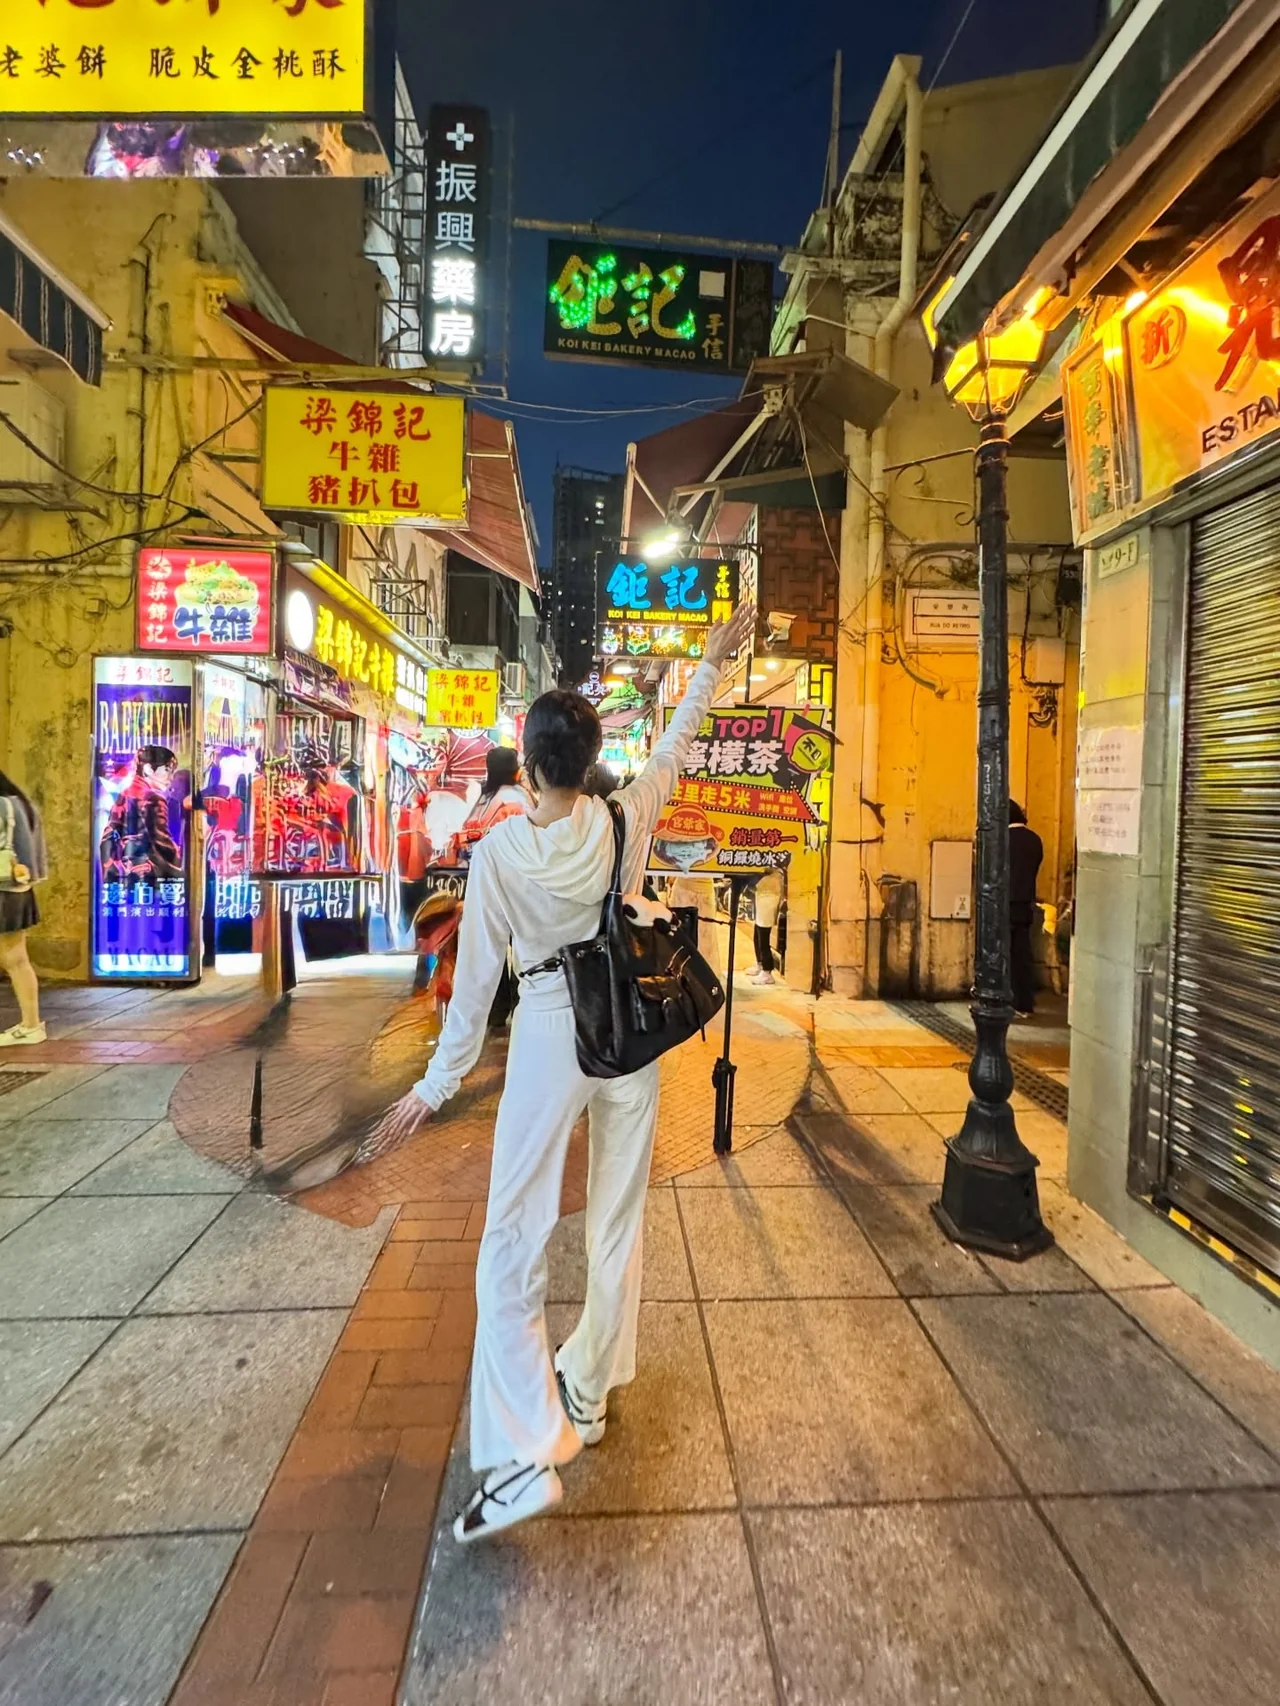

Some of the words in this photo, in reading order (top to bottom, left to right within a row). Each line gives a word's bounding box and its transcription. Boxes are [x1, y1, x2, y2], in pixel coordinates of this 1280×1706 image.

[0, 44, 107, 79] 老婆餅
[148, 45, 346, 80] 脆皮金桃酥
[430, 159, 477, 357] 振興藥房
[557, 337, 579, 349] KOI
[581, 339, 603, 351] KEI
[605, 342, 652, 356] BAKERY
[655, 347, 696, 361] MACAO
[299, 396, 432, 442] 梁錦記
[1202, 388, 1280, 454] ESTA
[327, 440, 401, 474] 牛雜
[307, 474, 421, 510] 豬扒包
[606, 563, 707, 610] 鉅記
[608, 610, 624, 619] KOI
[626, 610, 641, 619] KEI
[643, 610, 677, 622] BAKERY
[678, 612, 708, 622] MACAO
[99, 701, 188, 755] BAEKHYUN
